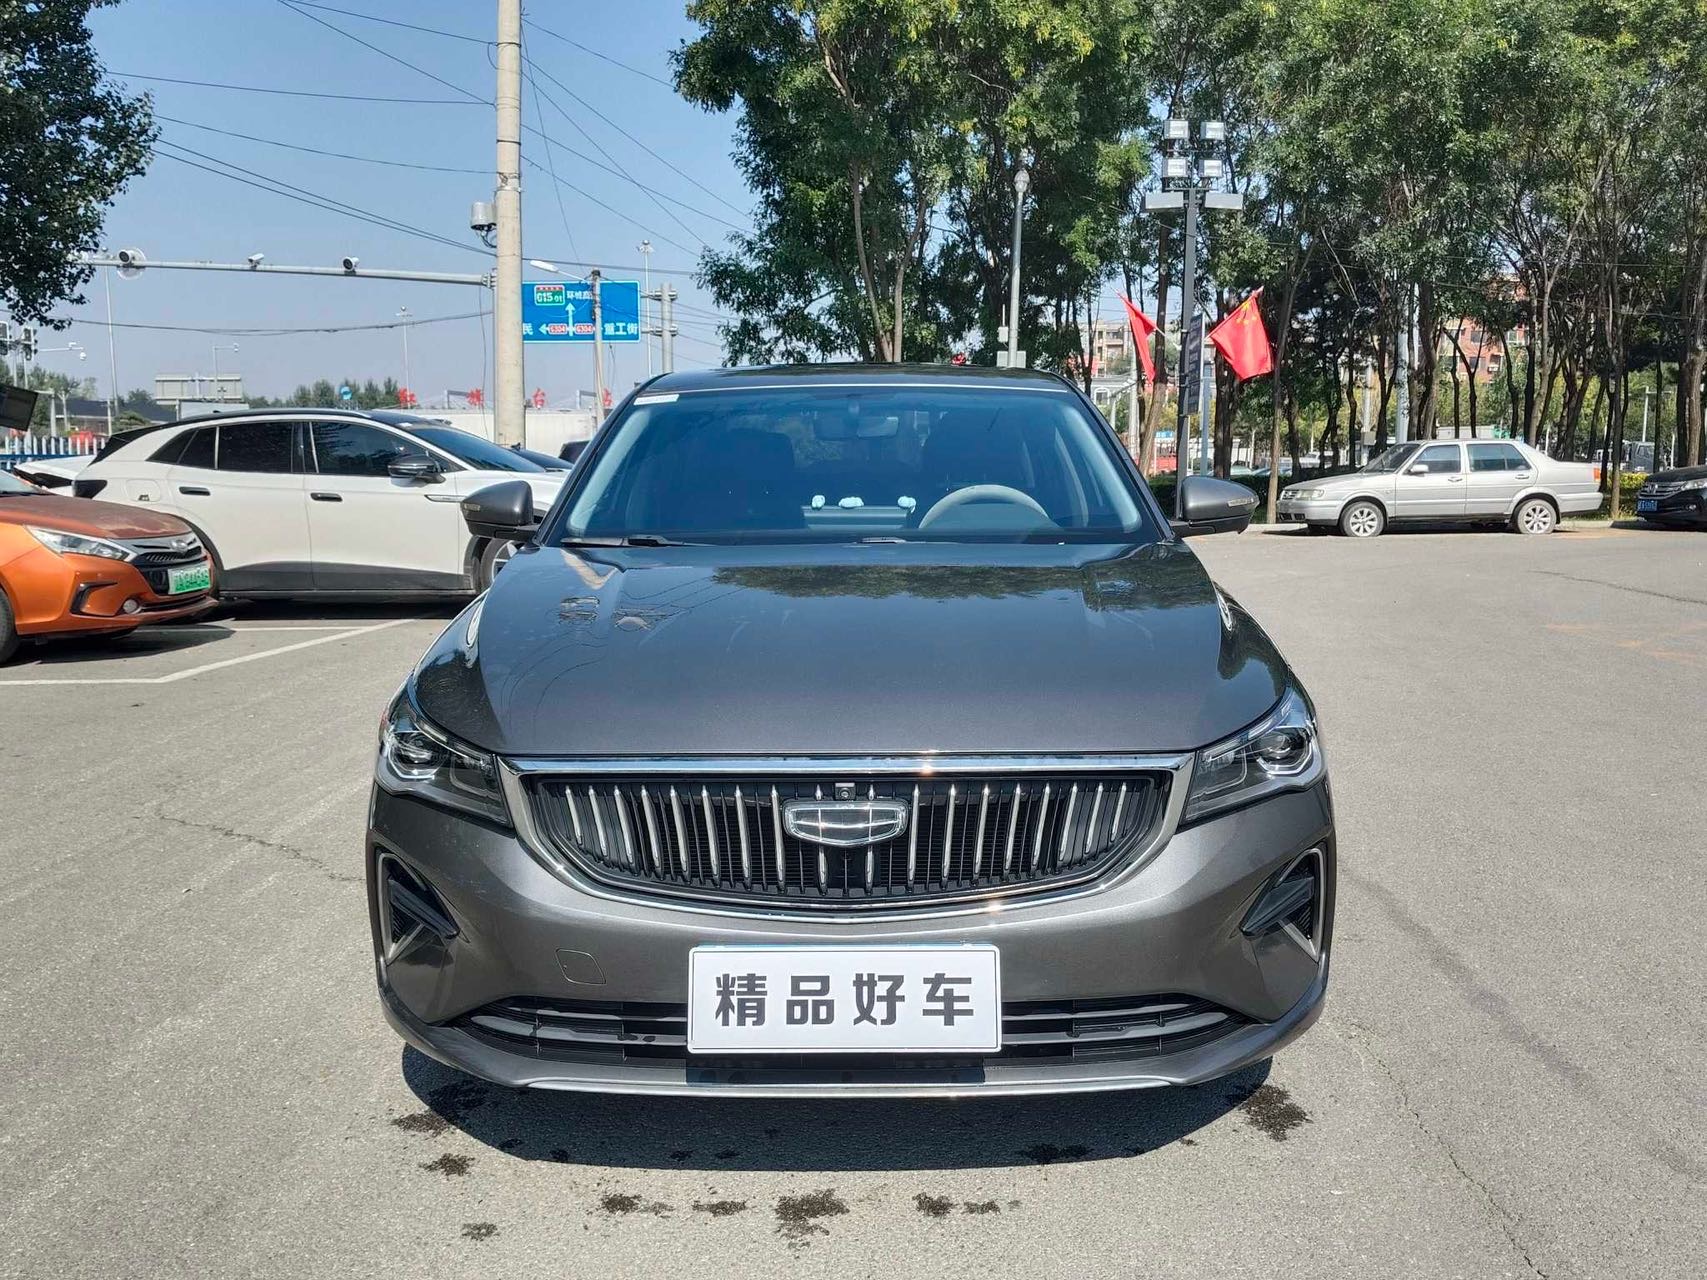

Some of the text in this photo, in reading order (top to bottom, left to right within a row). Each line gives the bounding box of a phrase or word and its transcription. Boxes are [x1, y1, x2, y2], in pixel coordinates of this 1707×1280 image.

[604, 323, 637, 335] 重工街
[715, 972, 974, 1027] 精品好车
